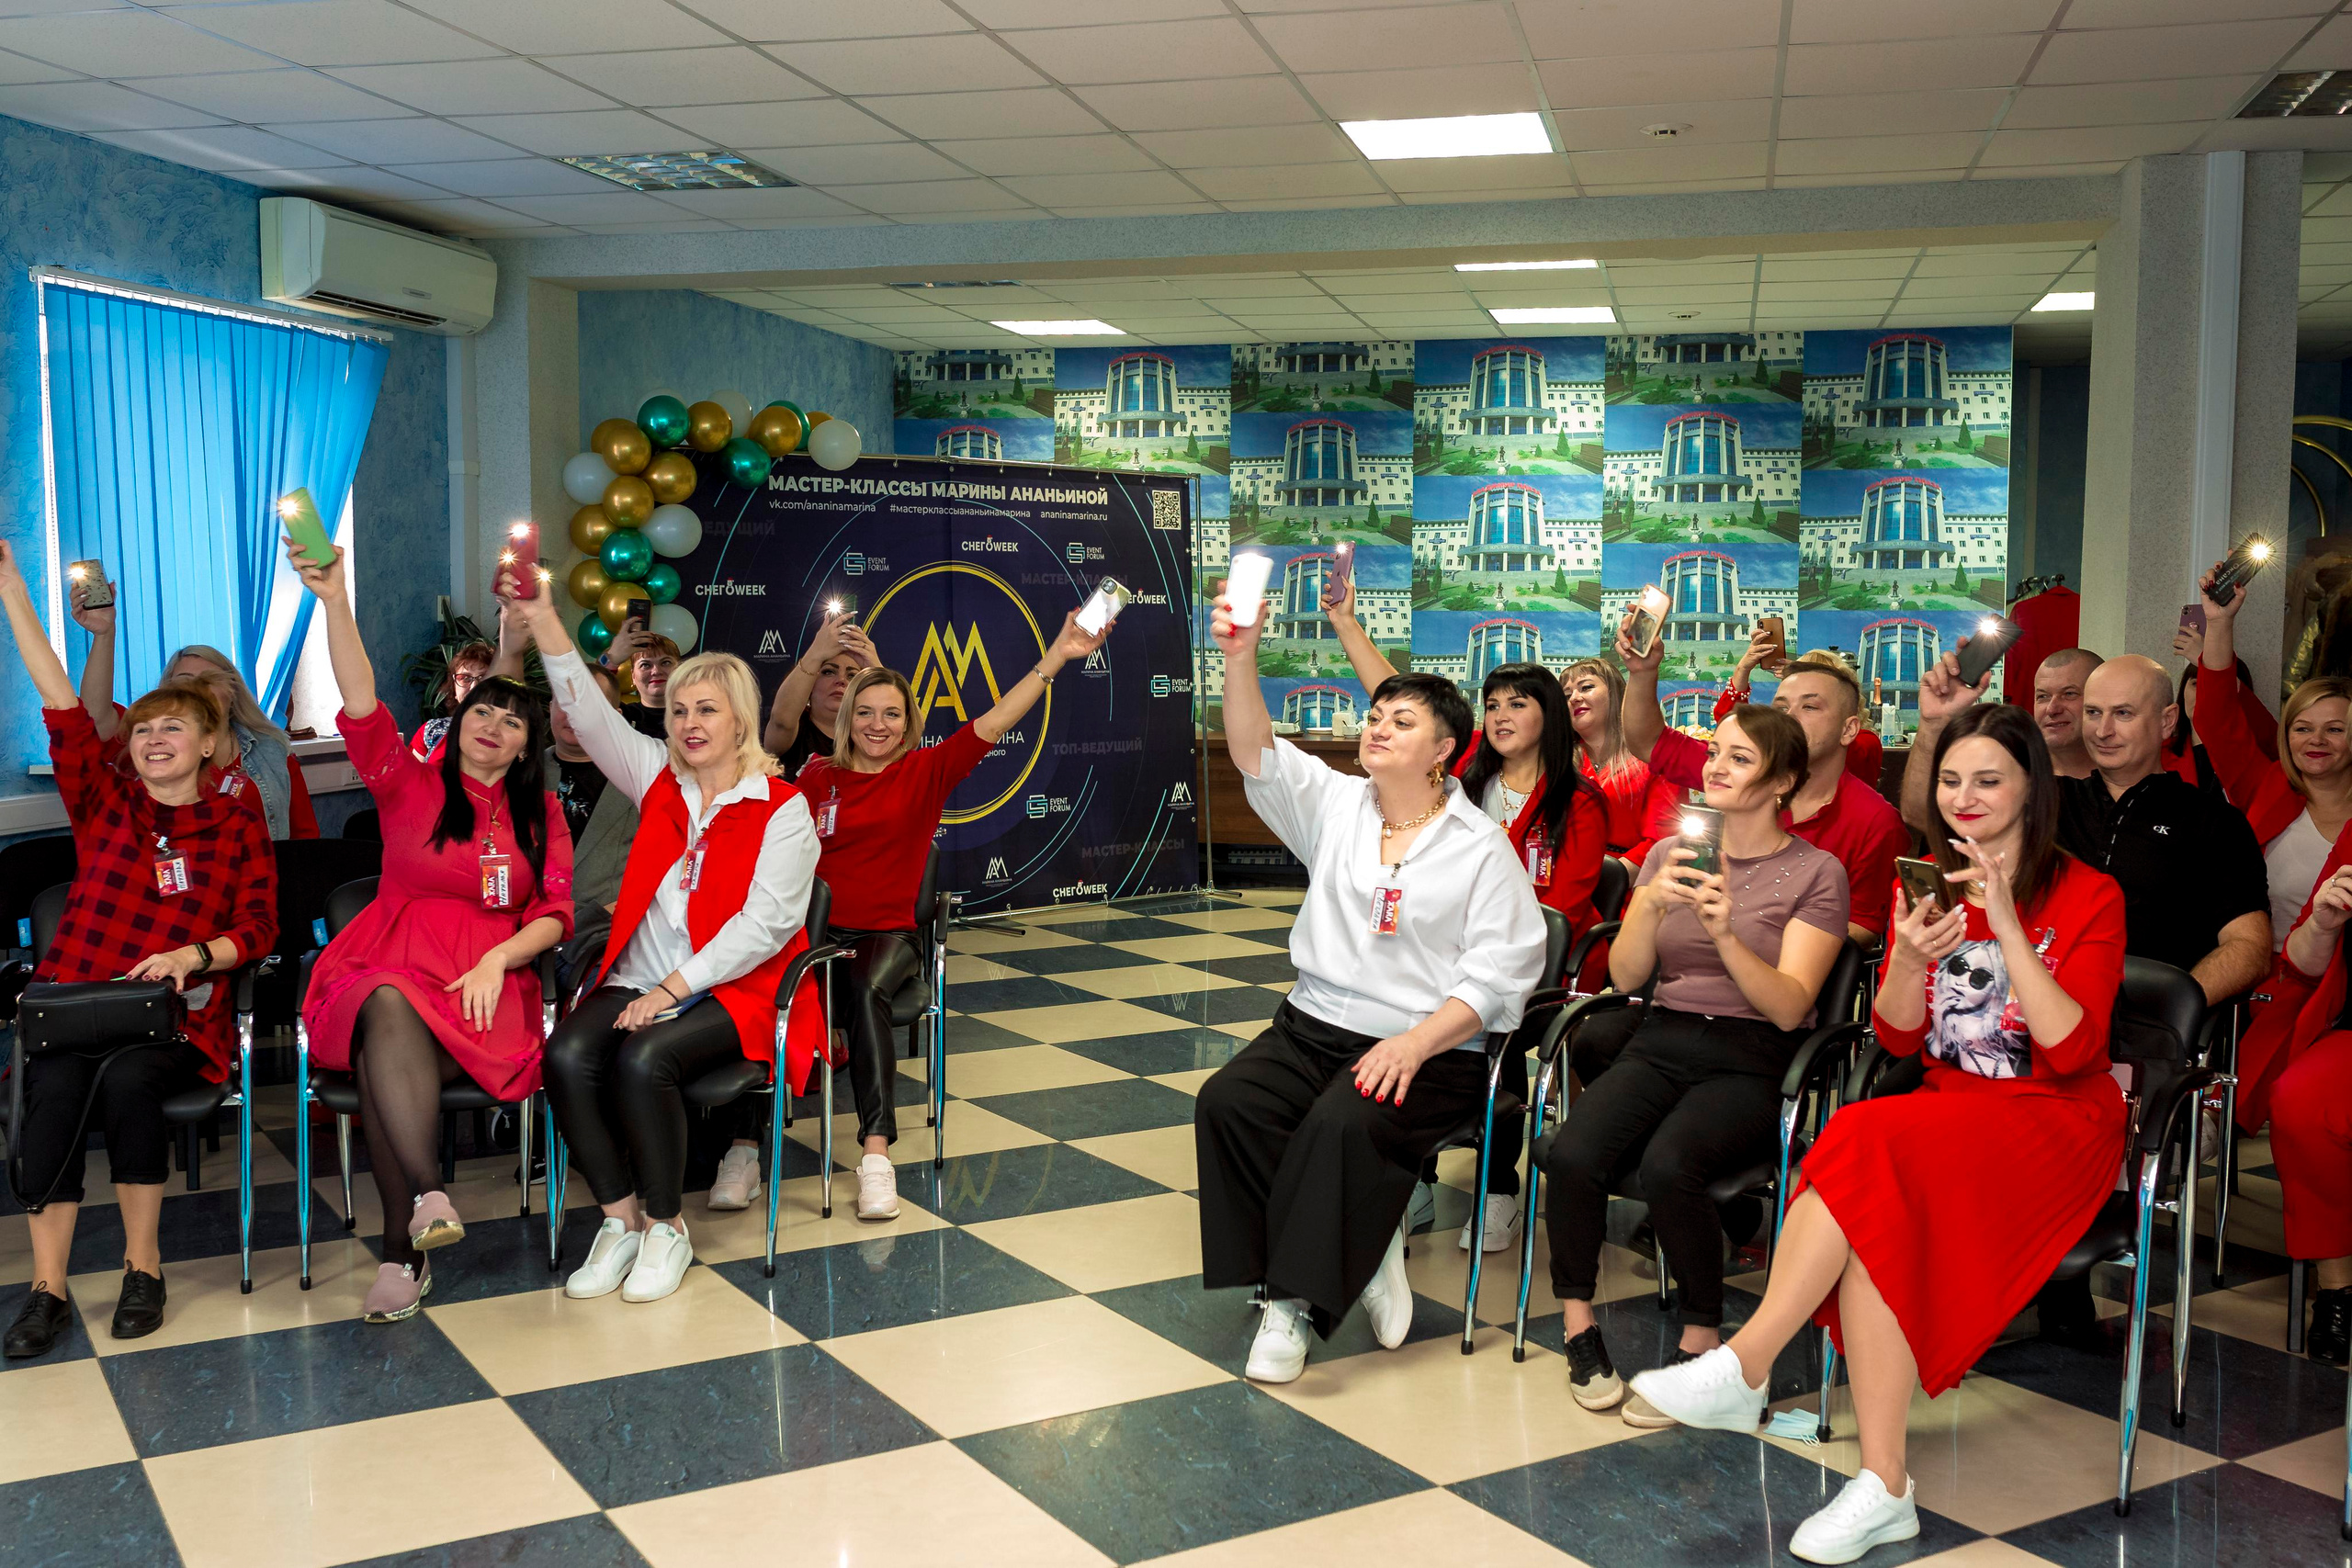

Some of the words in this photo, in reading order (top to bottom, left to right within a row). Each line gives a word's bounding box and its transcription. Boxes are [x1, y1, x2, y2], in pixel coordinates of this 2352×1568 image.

[768, 475, 927, 497] МАСТЕР-КЛАССЫ
[932, 482, 1006, 500] МАРИНЫ
[1011, 486, 1108, 505] АНАНЬИНОЙ
[769, 499, 876, 513] vk.com/ananinamarina
[889, 504, 1031, 518] #мастерклассыананьинамарина
[1041, 511, 1108, 522] ananinamarina.ru
[1052, 737, 1143, 756] ТОП-ВЕДУЩИЙ
[1050, 797, 1069, 806] EVENT
[1050, 804, 1071, 812] FORUM
